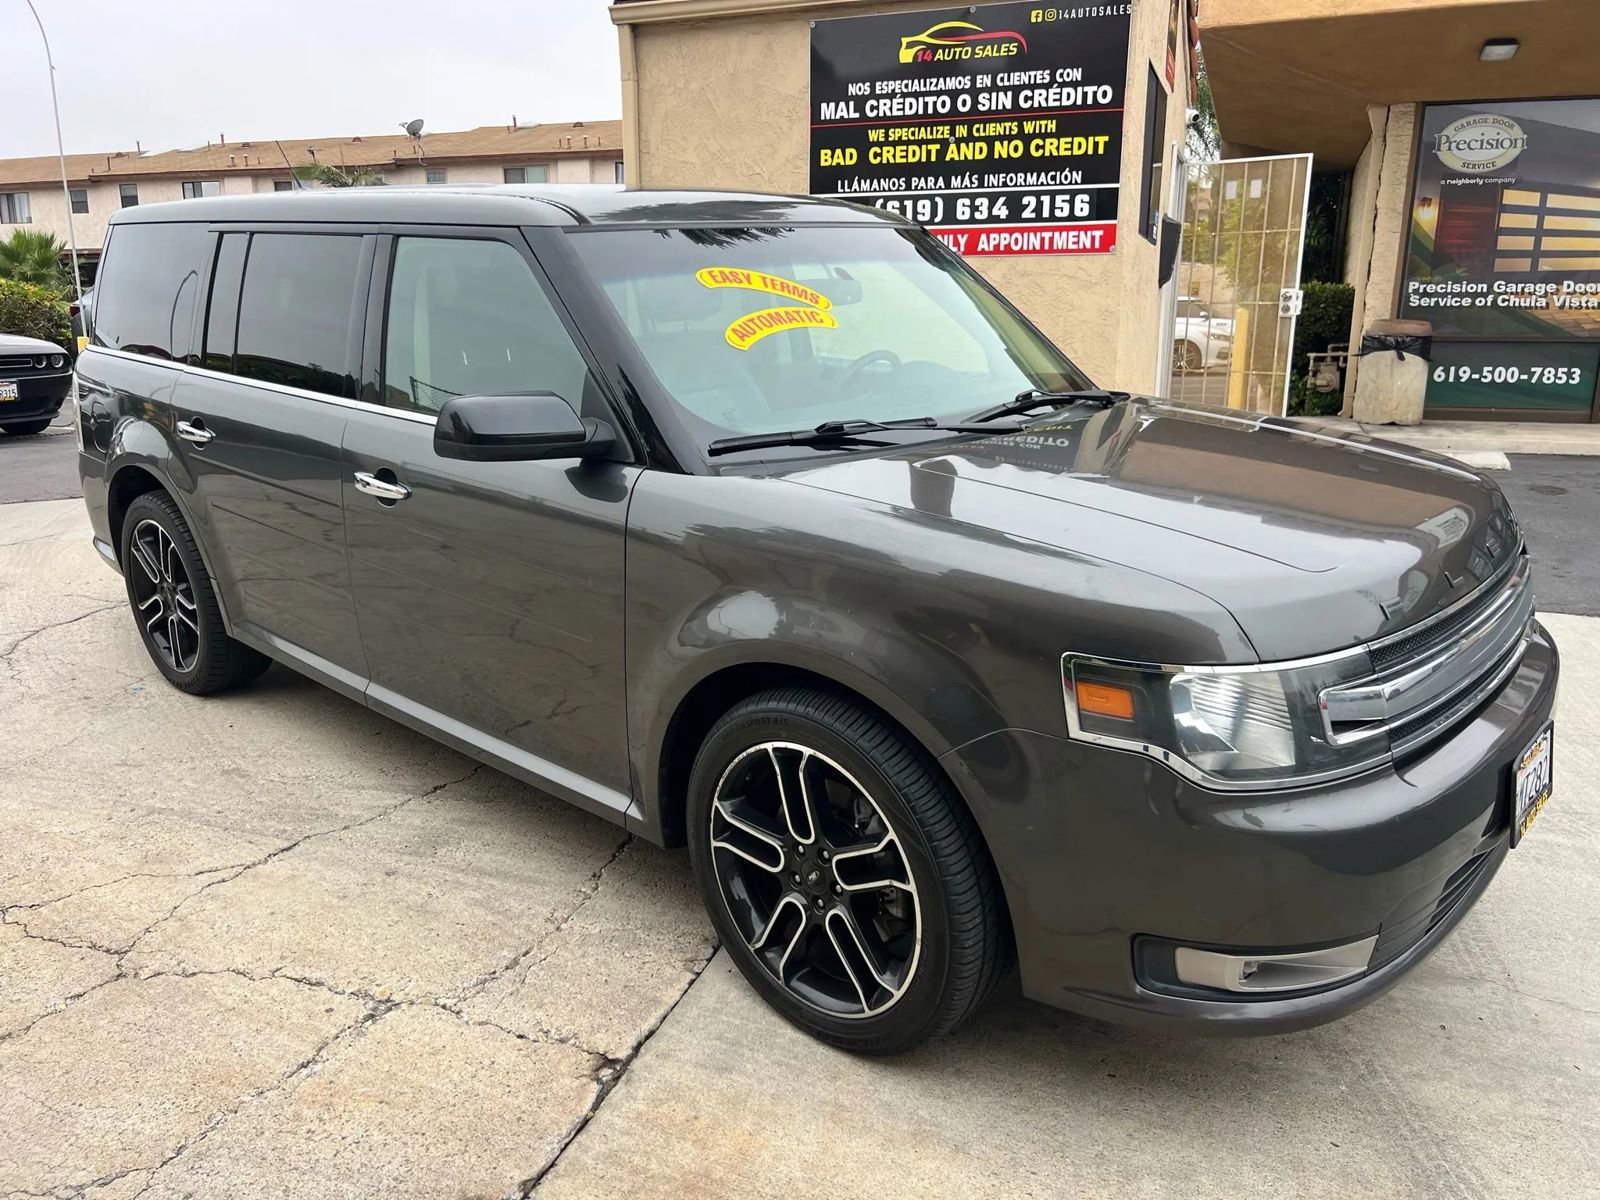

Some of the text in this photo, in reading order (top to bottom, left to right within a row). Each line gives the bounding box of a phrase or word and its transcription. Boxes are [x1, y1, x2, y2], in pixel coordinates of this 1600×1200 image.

[1059, 4, 1132, 20] 14AUTOSALES
[916, 42, 1018, 62] 14 AUTO SALES
[848, 68, 1082, 96] NOS ESPECIALIZAMOS EN CLIENTES CON
[820, 84, 1113, 120] MAL CRÉDITO O SIN CRÉDITO
[868, 120, 1057, 142] WE SPECIALIZE IN CLIENTS WITH
[1454, 118, 1516, 132] GARAGE DOOR
[820, 136, 1110, 166] BAD CREDIT AND NO CREDIT
[1433, 132, 1528, 152] Precision
[1460, 160, 1497, 170] SERVICE
[838, 168, 1082, 192] LLÁMANOS PARA MÁS INFORMACIÓN
[1446, 178, 1484, 186] neighborly
[956, 196, 1008, 220] 634
[1021, 194, 1090, 219] 2156
[936, 230, 1104, 252] NLY APPOINTMENT
[708, 270, 820, 305] EASY TERMS
[1408, 280, 1488, 293] Precision
[1493, 280, 1556, 296] Garage
[1409, 294, 1599, 307] Service of Chula Vista
[730, 310, 824, 342] AUTOMATIC
[1433, 366, 1581, 384] 619-500-7853
